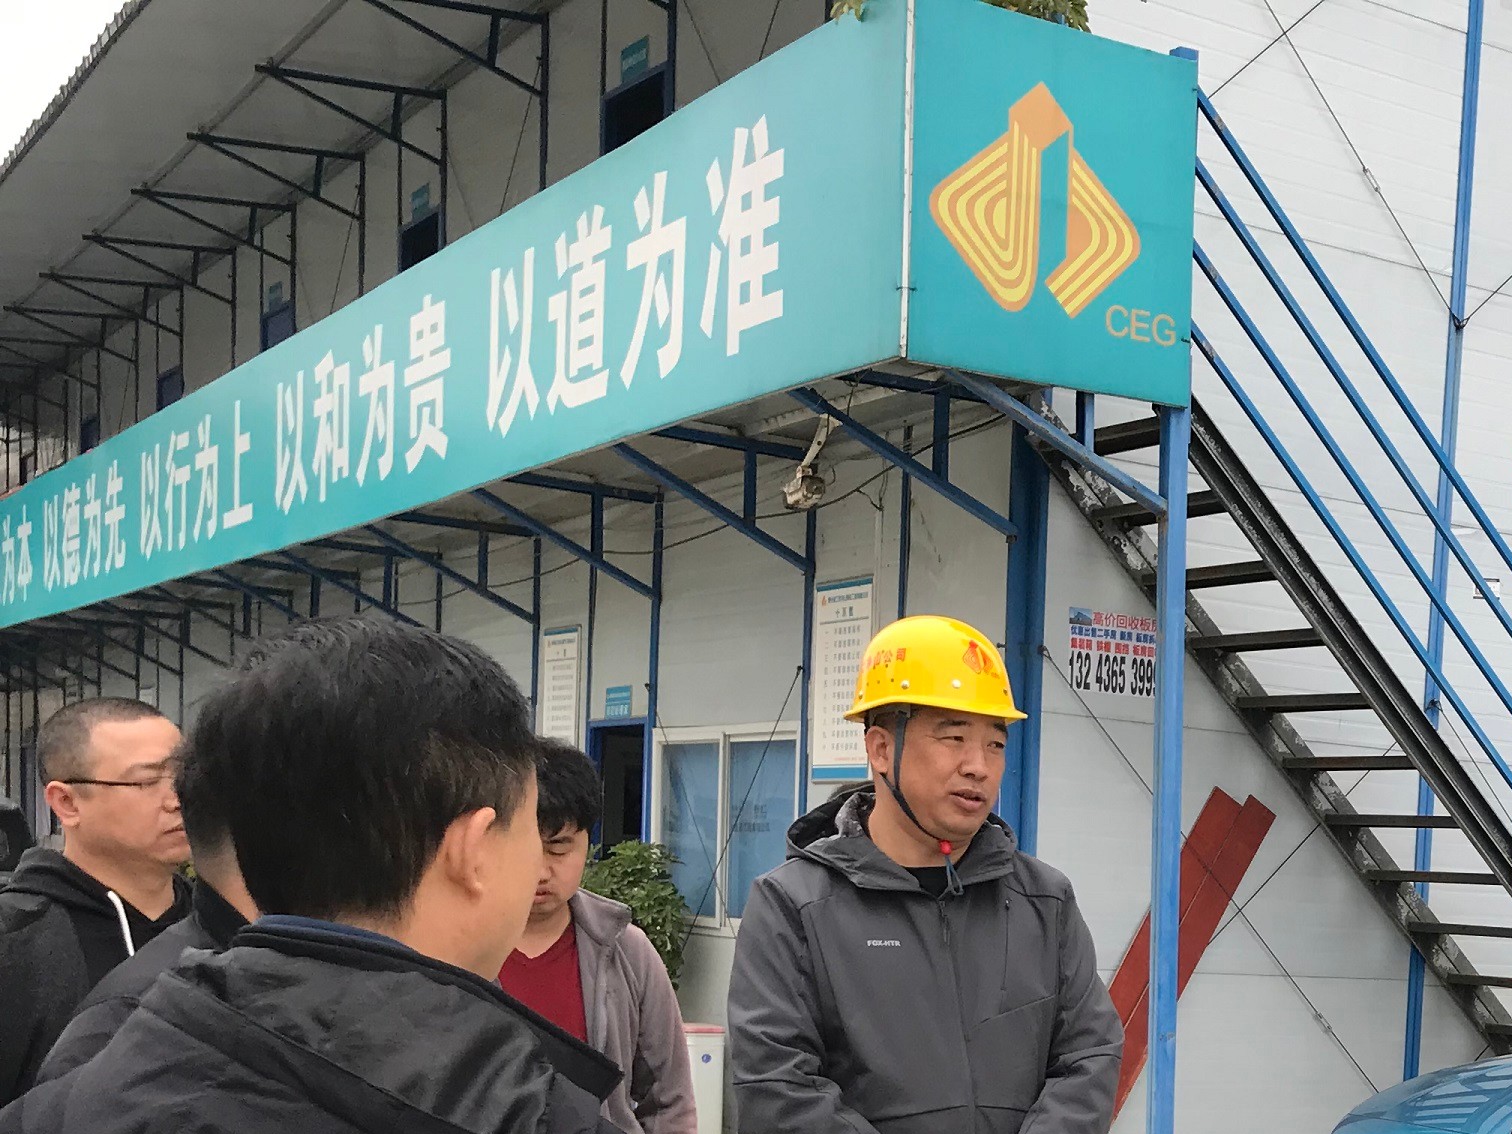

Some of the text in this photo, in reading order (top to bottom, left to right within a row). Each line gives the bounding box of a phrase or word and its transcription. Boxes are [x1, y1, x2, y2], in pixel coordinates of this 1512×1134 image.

[1105, 304, 1176, 346] CEG
[43, 459, 126, 592] 以德为先
[140, 400, 253, 560] 以行为上
[275, 294, 452, 515] 以和为贵
[486, 114, 785, 438] 以道为准
[1069, 650, 1091, 690] 132
[1096, 654, 1126, 694] 4365
